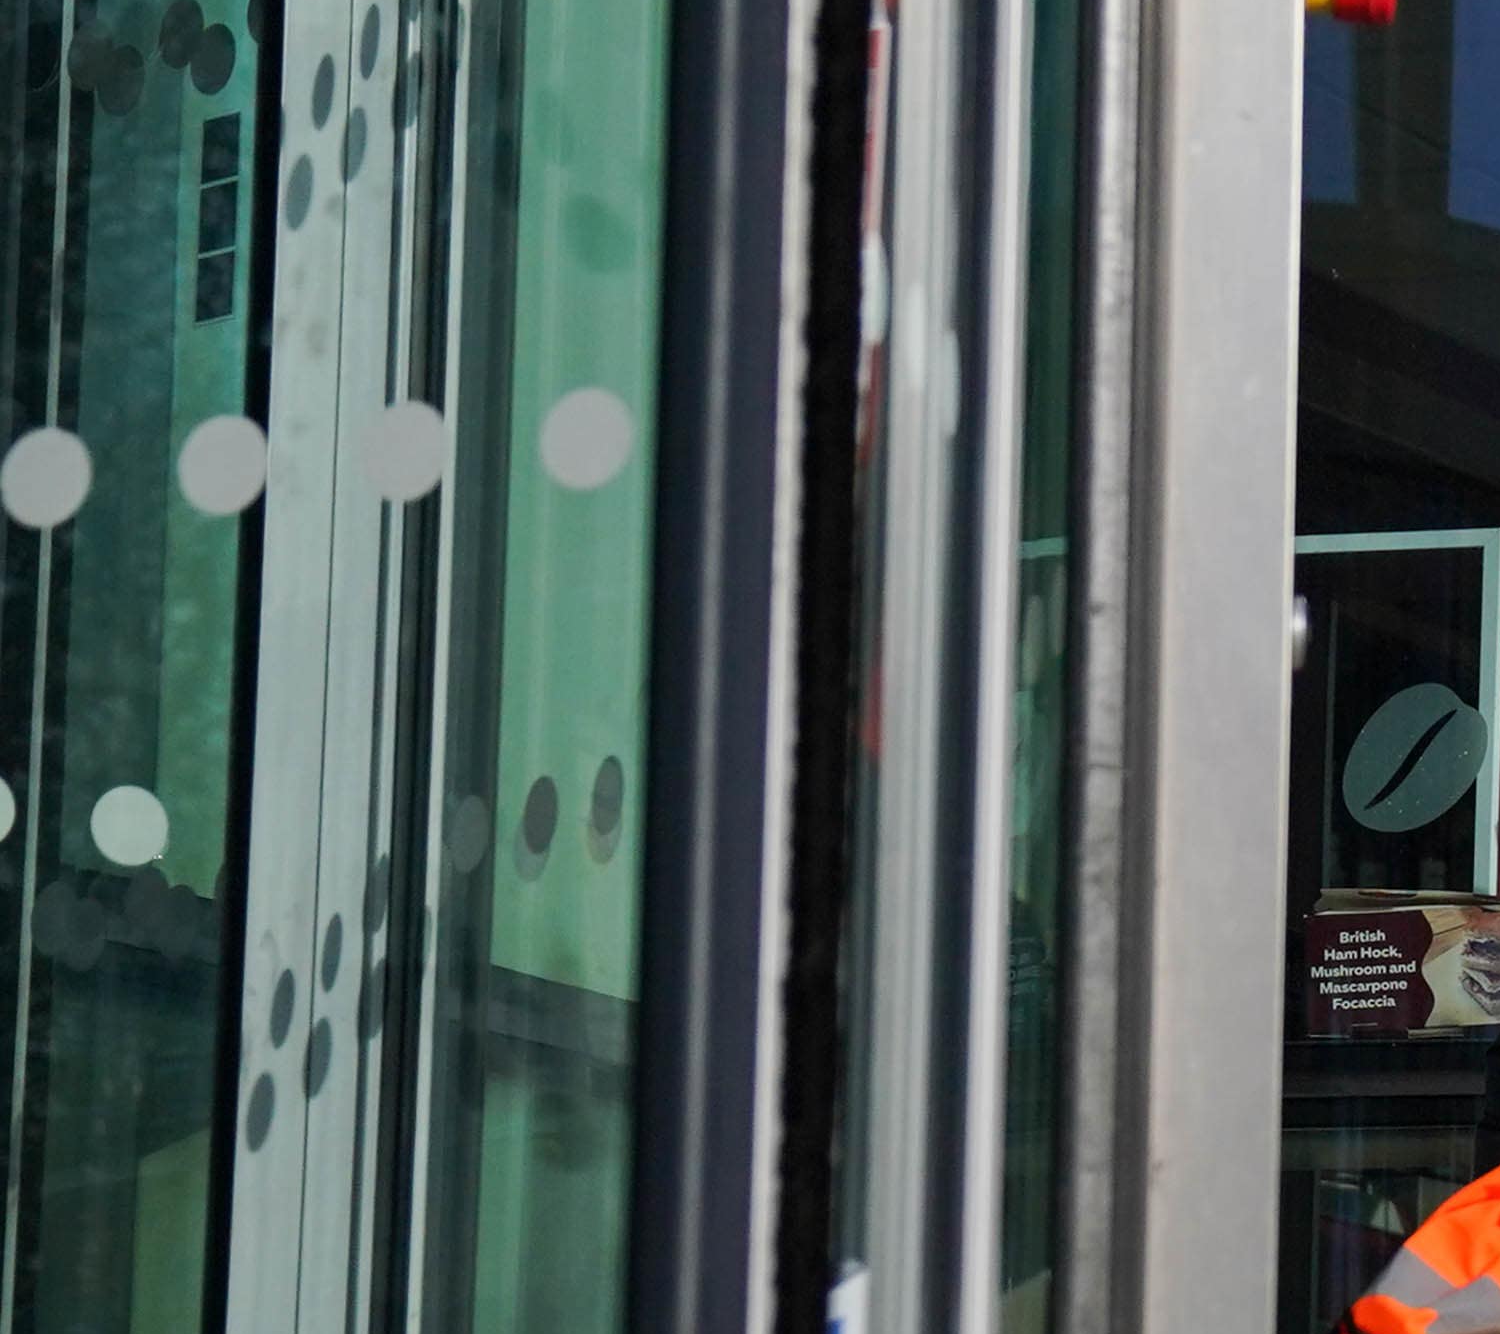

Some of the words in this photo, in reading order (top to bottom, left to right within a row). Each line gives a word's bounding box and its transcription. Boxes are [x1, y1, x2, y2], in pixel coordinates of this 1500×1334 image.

[1339, 930, 1386, 944] British
[1324, 949, 1358, 961] Ham
[1361, 946, 1402, 959] Hock,
[1311, 964, 1387, 978] Mushroom
[1389, 961, 1417, 974] and
[1320, 980, 1408, 994] Mascarpone
[1332, 996, 1396, 1010] Focaccia
